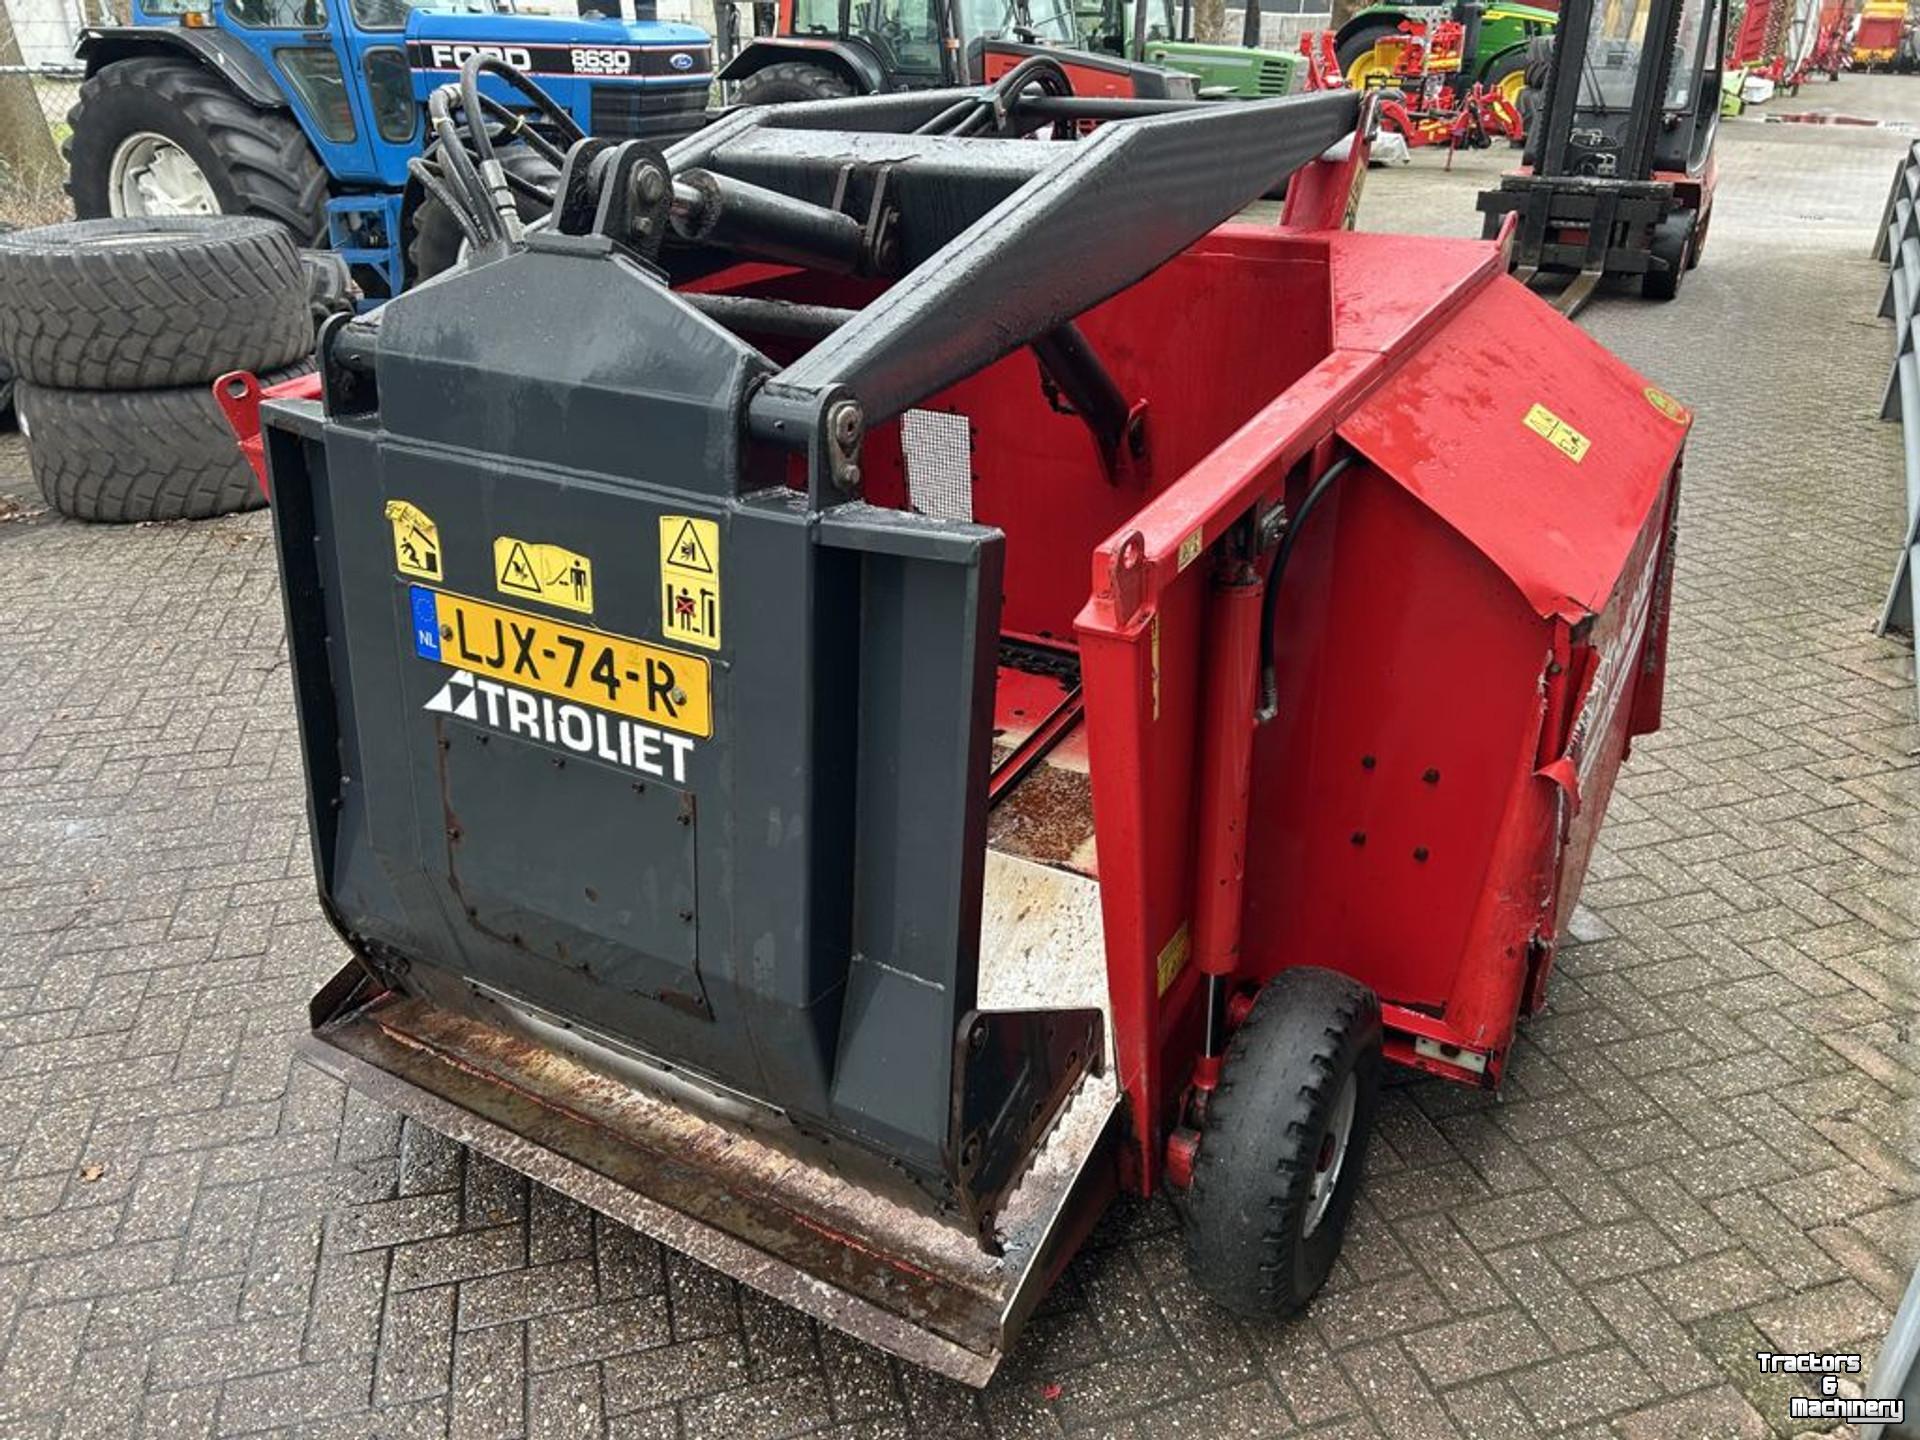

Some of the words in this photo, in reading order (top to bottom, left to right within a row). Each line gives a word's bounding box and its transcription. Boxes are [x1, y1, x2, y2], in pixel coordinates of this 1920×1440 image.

[571, 49, 631, 67] 8630
[418, 630, 438, 649] NL
[456, 608, 679, 719] LJX-74-R
[475, 679, 695, 784] TRIOLIET
